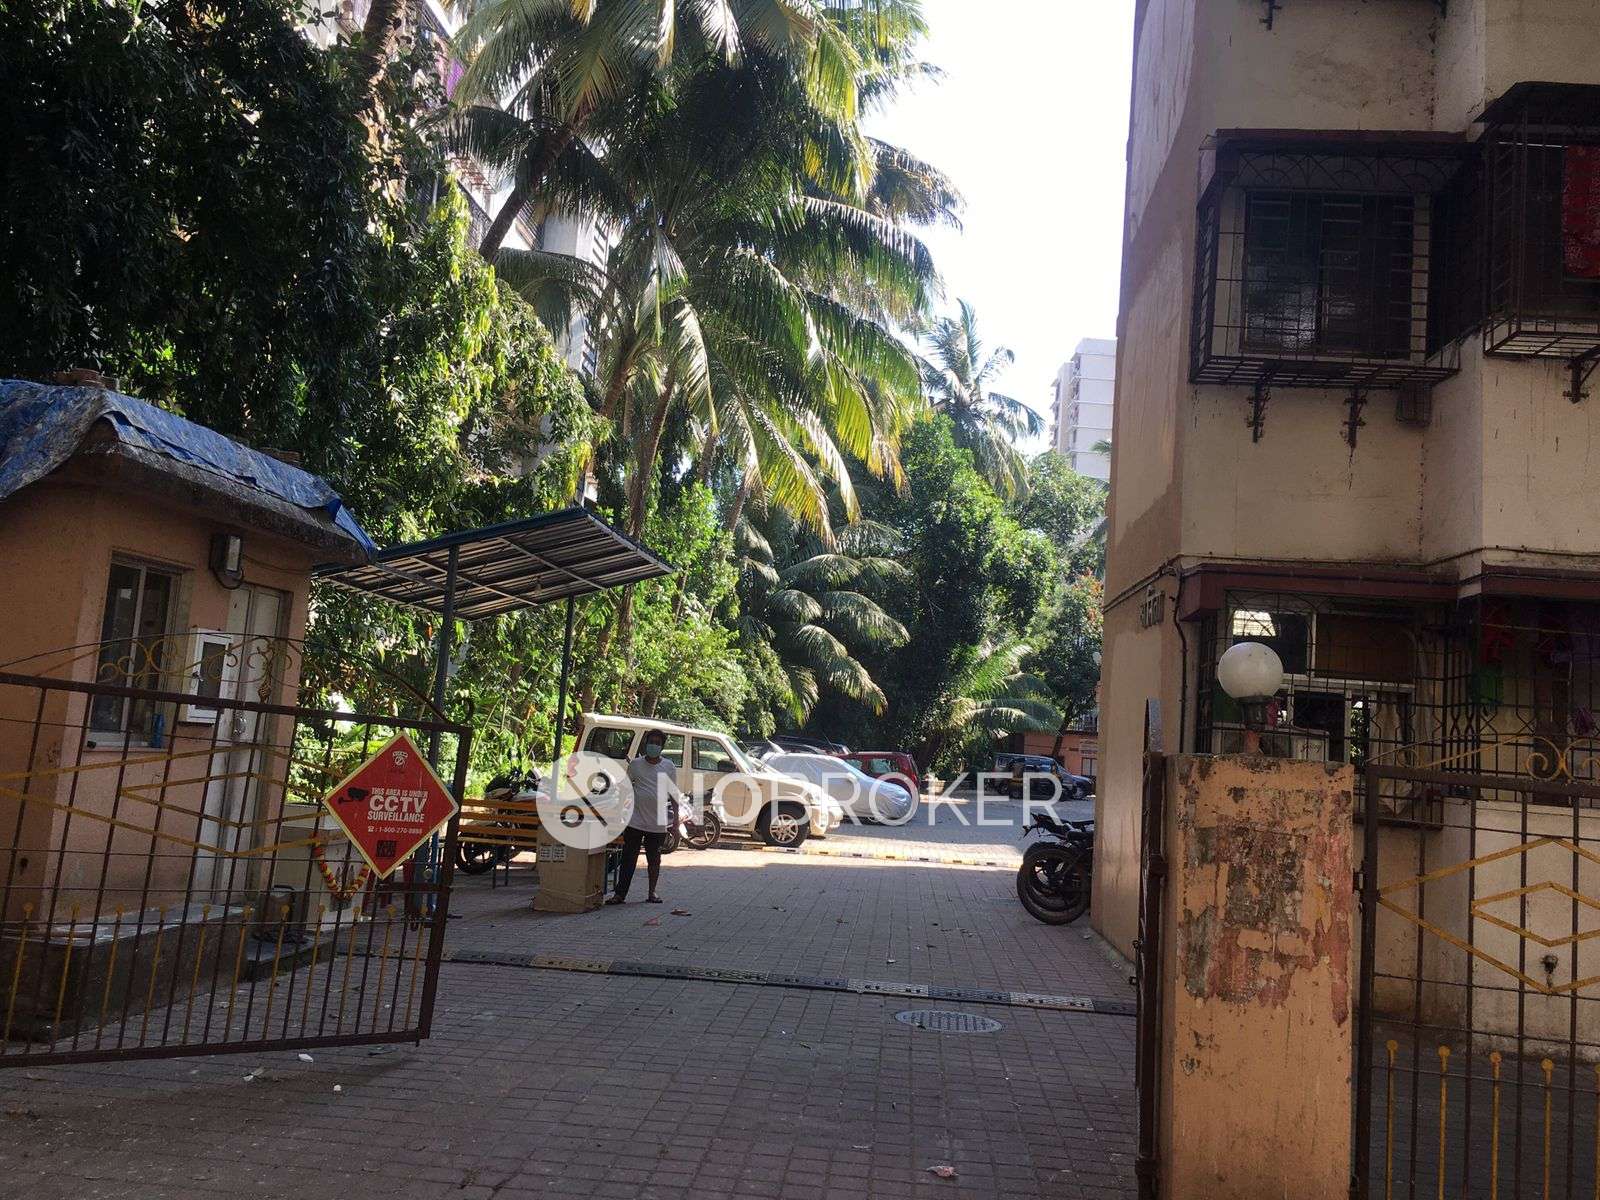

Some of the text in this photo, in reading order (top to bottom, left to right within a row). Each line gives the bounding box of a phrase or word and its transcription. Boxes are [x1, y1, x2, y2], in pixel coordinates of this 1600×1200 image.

[371, 787, 385, 795] THIS
[385, 788, 401, 796] AREA
[409, 790, 428, 798] UNDER
[369, 795, 427, 813] CCTV
[367, 811, 425, 822] SURVEILLANCE
